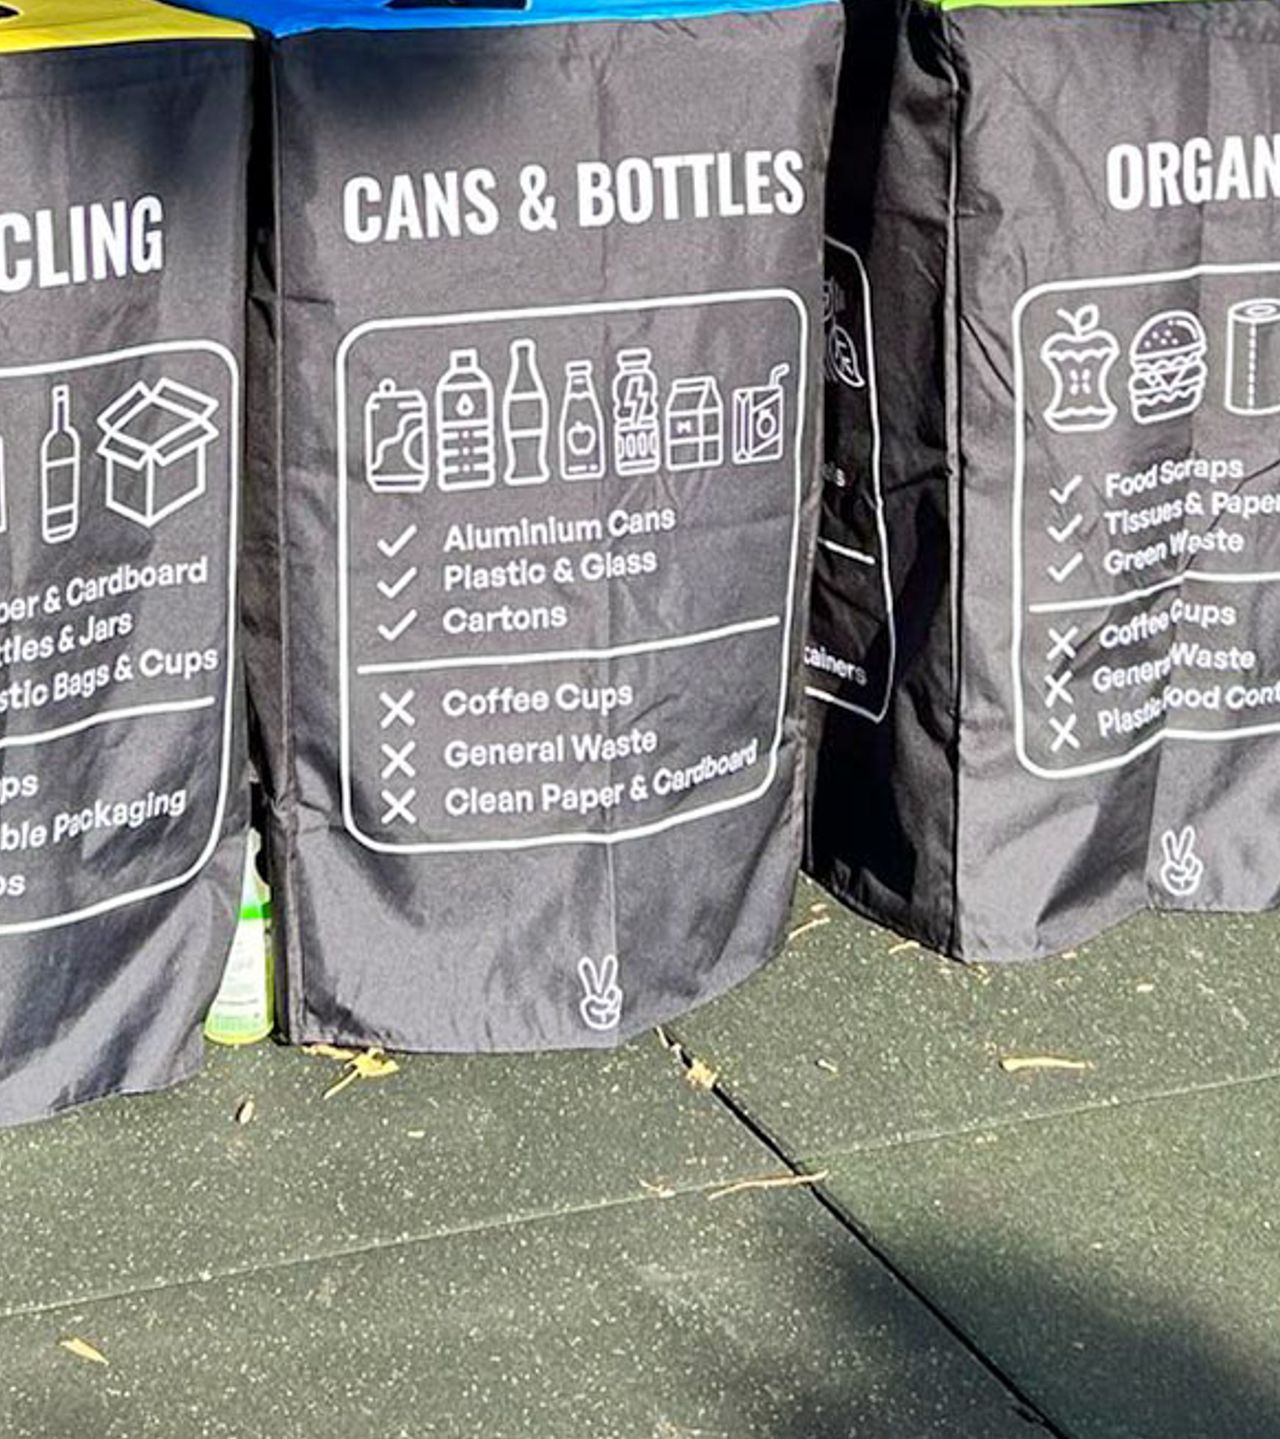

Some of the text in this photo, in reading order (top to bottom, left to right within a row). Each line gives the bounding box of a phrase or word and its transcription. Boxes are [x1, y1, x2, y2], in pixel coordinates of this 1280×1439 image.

[343, 149, 804, 243] CANS & BOTTLES
[1105, 458, 1245, 499] Food Scraps
[443, 508, 676, 553] Aluminium Cans
[1103, 499, 1183, 535] Tissues
[1184, 491, 1205, 516] &
[444, 551, 657, 592] Plastic & Glass
[1102, 529, 1245, 576] Green Waste
[43, 587, 62, 614] &
[66, 555, 208, 606] Cardboard
[57, 629, 75, 653] &
[79, 612, 133, 647] Jars
[442, 605, 568, 634] Cartons
[1099, 598, 1236, 648] Coffee Cups
[53, 664, 110, 701] Bags
[114, 658, 134, 681] &
[138, 649, 218, 680] Cups
[1168, 642, 1256, 670] Waste
[442, 684, 633, 717] Coffee Cups
[444, 727, 657, 769] General Waste
[445, 738, 758, 816] Clean Paper & Cardboard
[53, 789, 187, 843] Packaging
